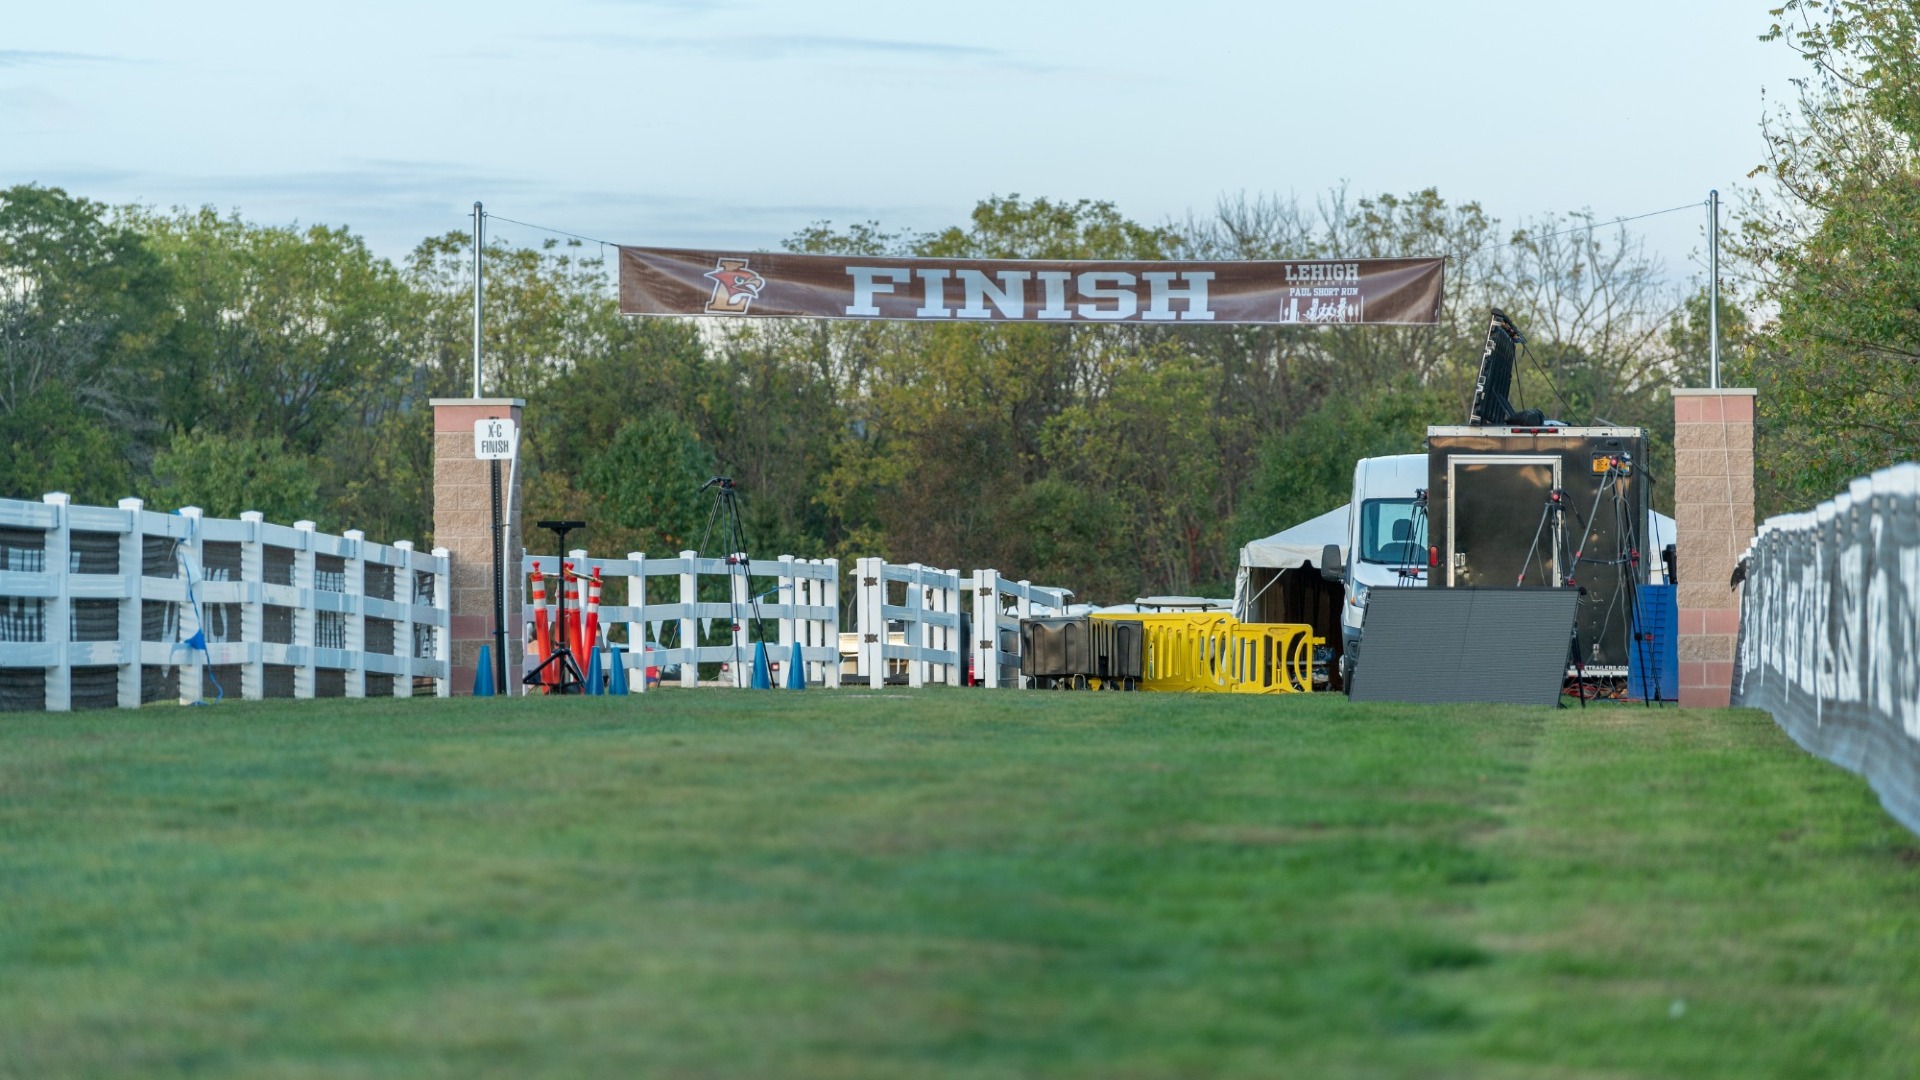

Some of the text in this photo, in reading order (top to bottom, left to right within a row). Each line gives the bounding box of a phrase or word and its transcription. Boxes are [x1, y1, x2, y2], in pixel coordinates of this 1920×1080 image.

[1284, 264, 1359, 281] LEHIGH
[845, 266, 1215, 320] FINISH
[1289, 287, 1359, 296] PAUL SHORT RUN
[481, 440, 509, 453] FINISH
